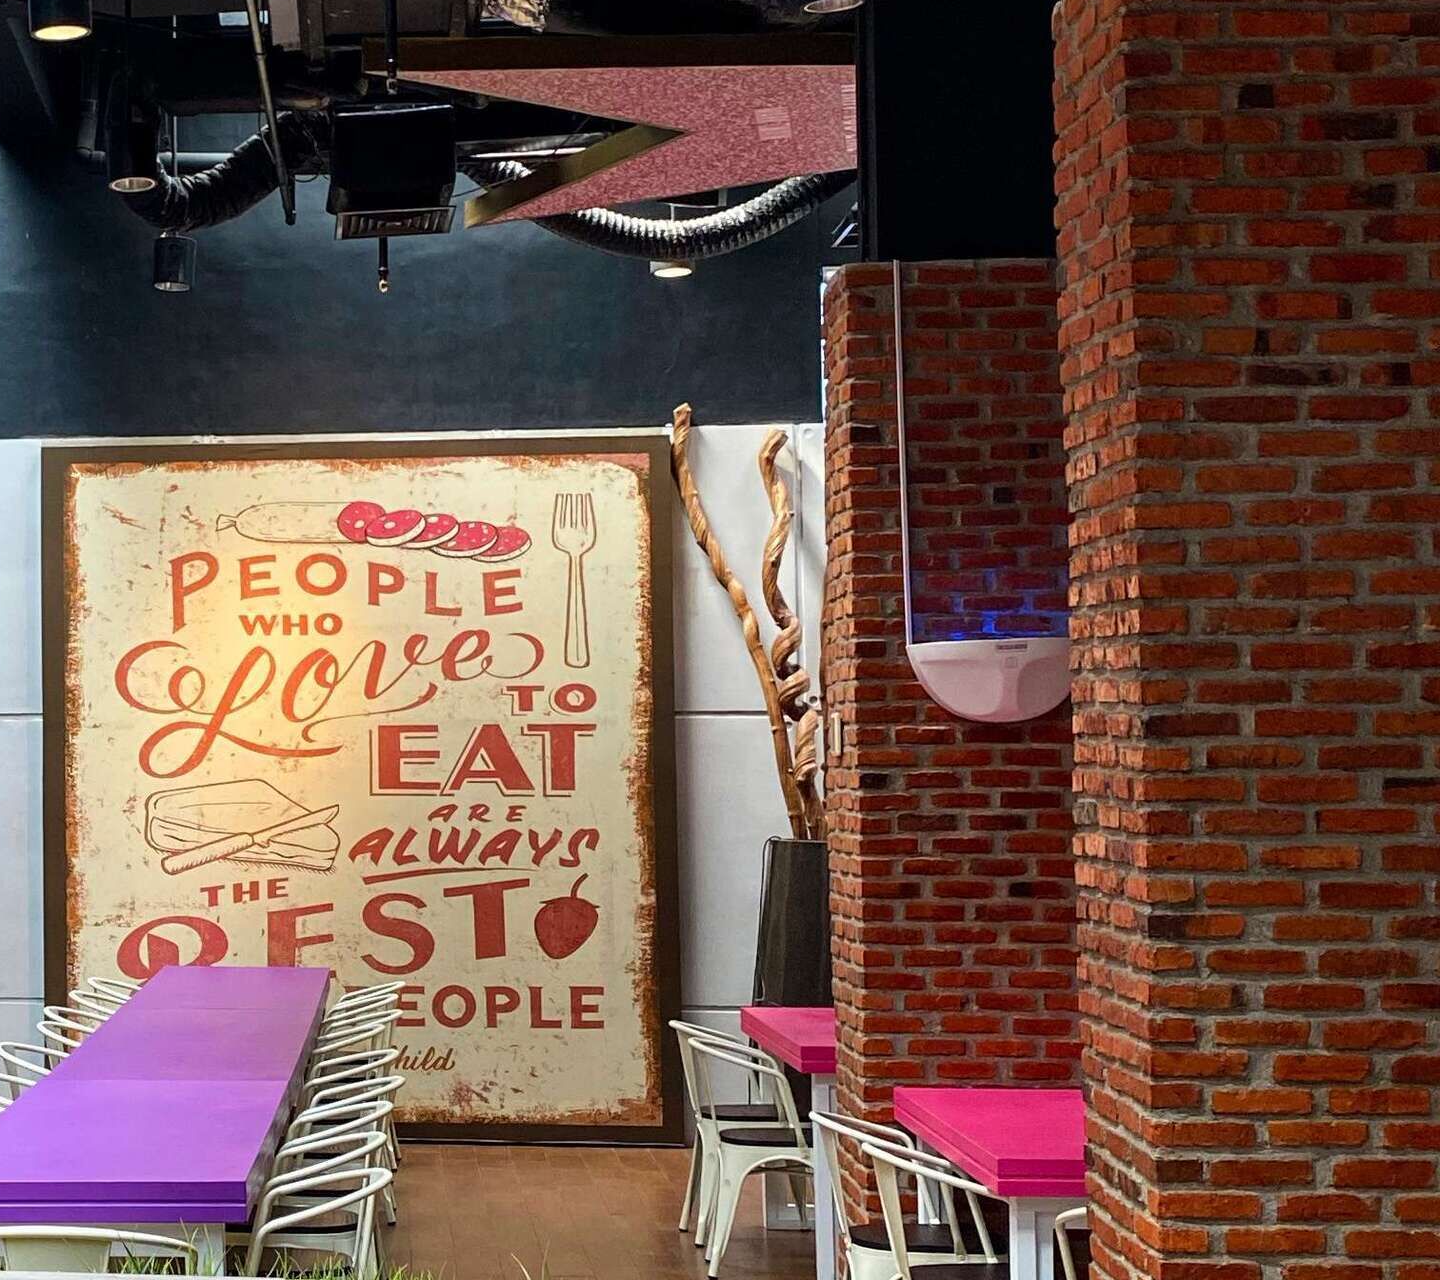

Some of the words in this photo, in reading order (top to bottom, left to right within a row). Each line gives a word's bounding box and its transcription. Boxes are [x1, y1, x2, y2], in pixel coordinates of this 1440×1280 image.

[168, 550, 524, 635] PEOPLE
[238, 612, 344, 637] WHO
[114, 627, 545, 780] Love
[501, 682, 598, 717] TO
[368, 722, 598, 798] EAT
[426, 803, 527, 823] ARE
[347, 825, 601, 868] ALWAYS
[199, 876, 290, 908] THE
[344, 983, 606, 1029] EOPLE
[388, 1044, 456, 1072] hild
